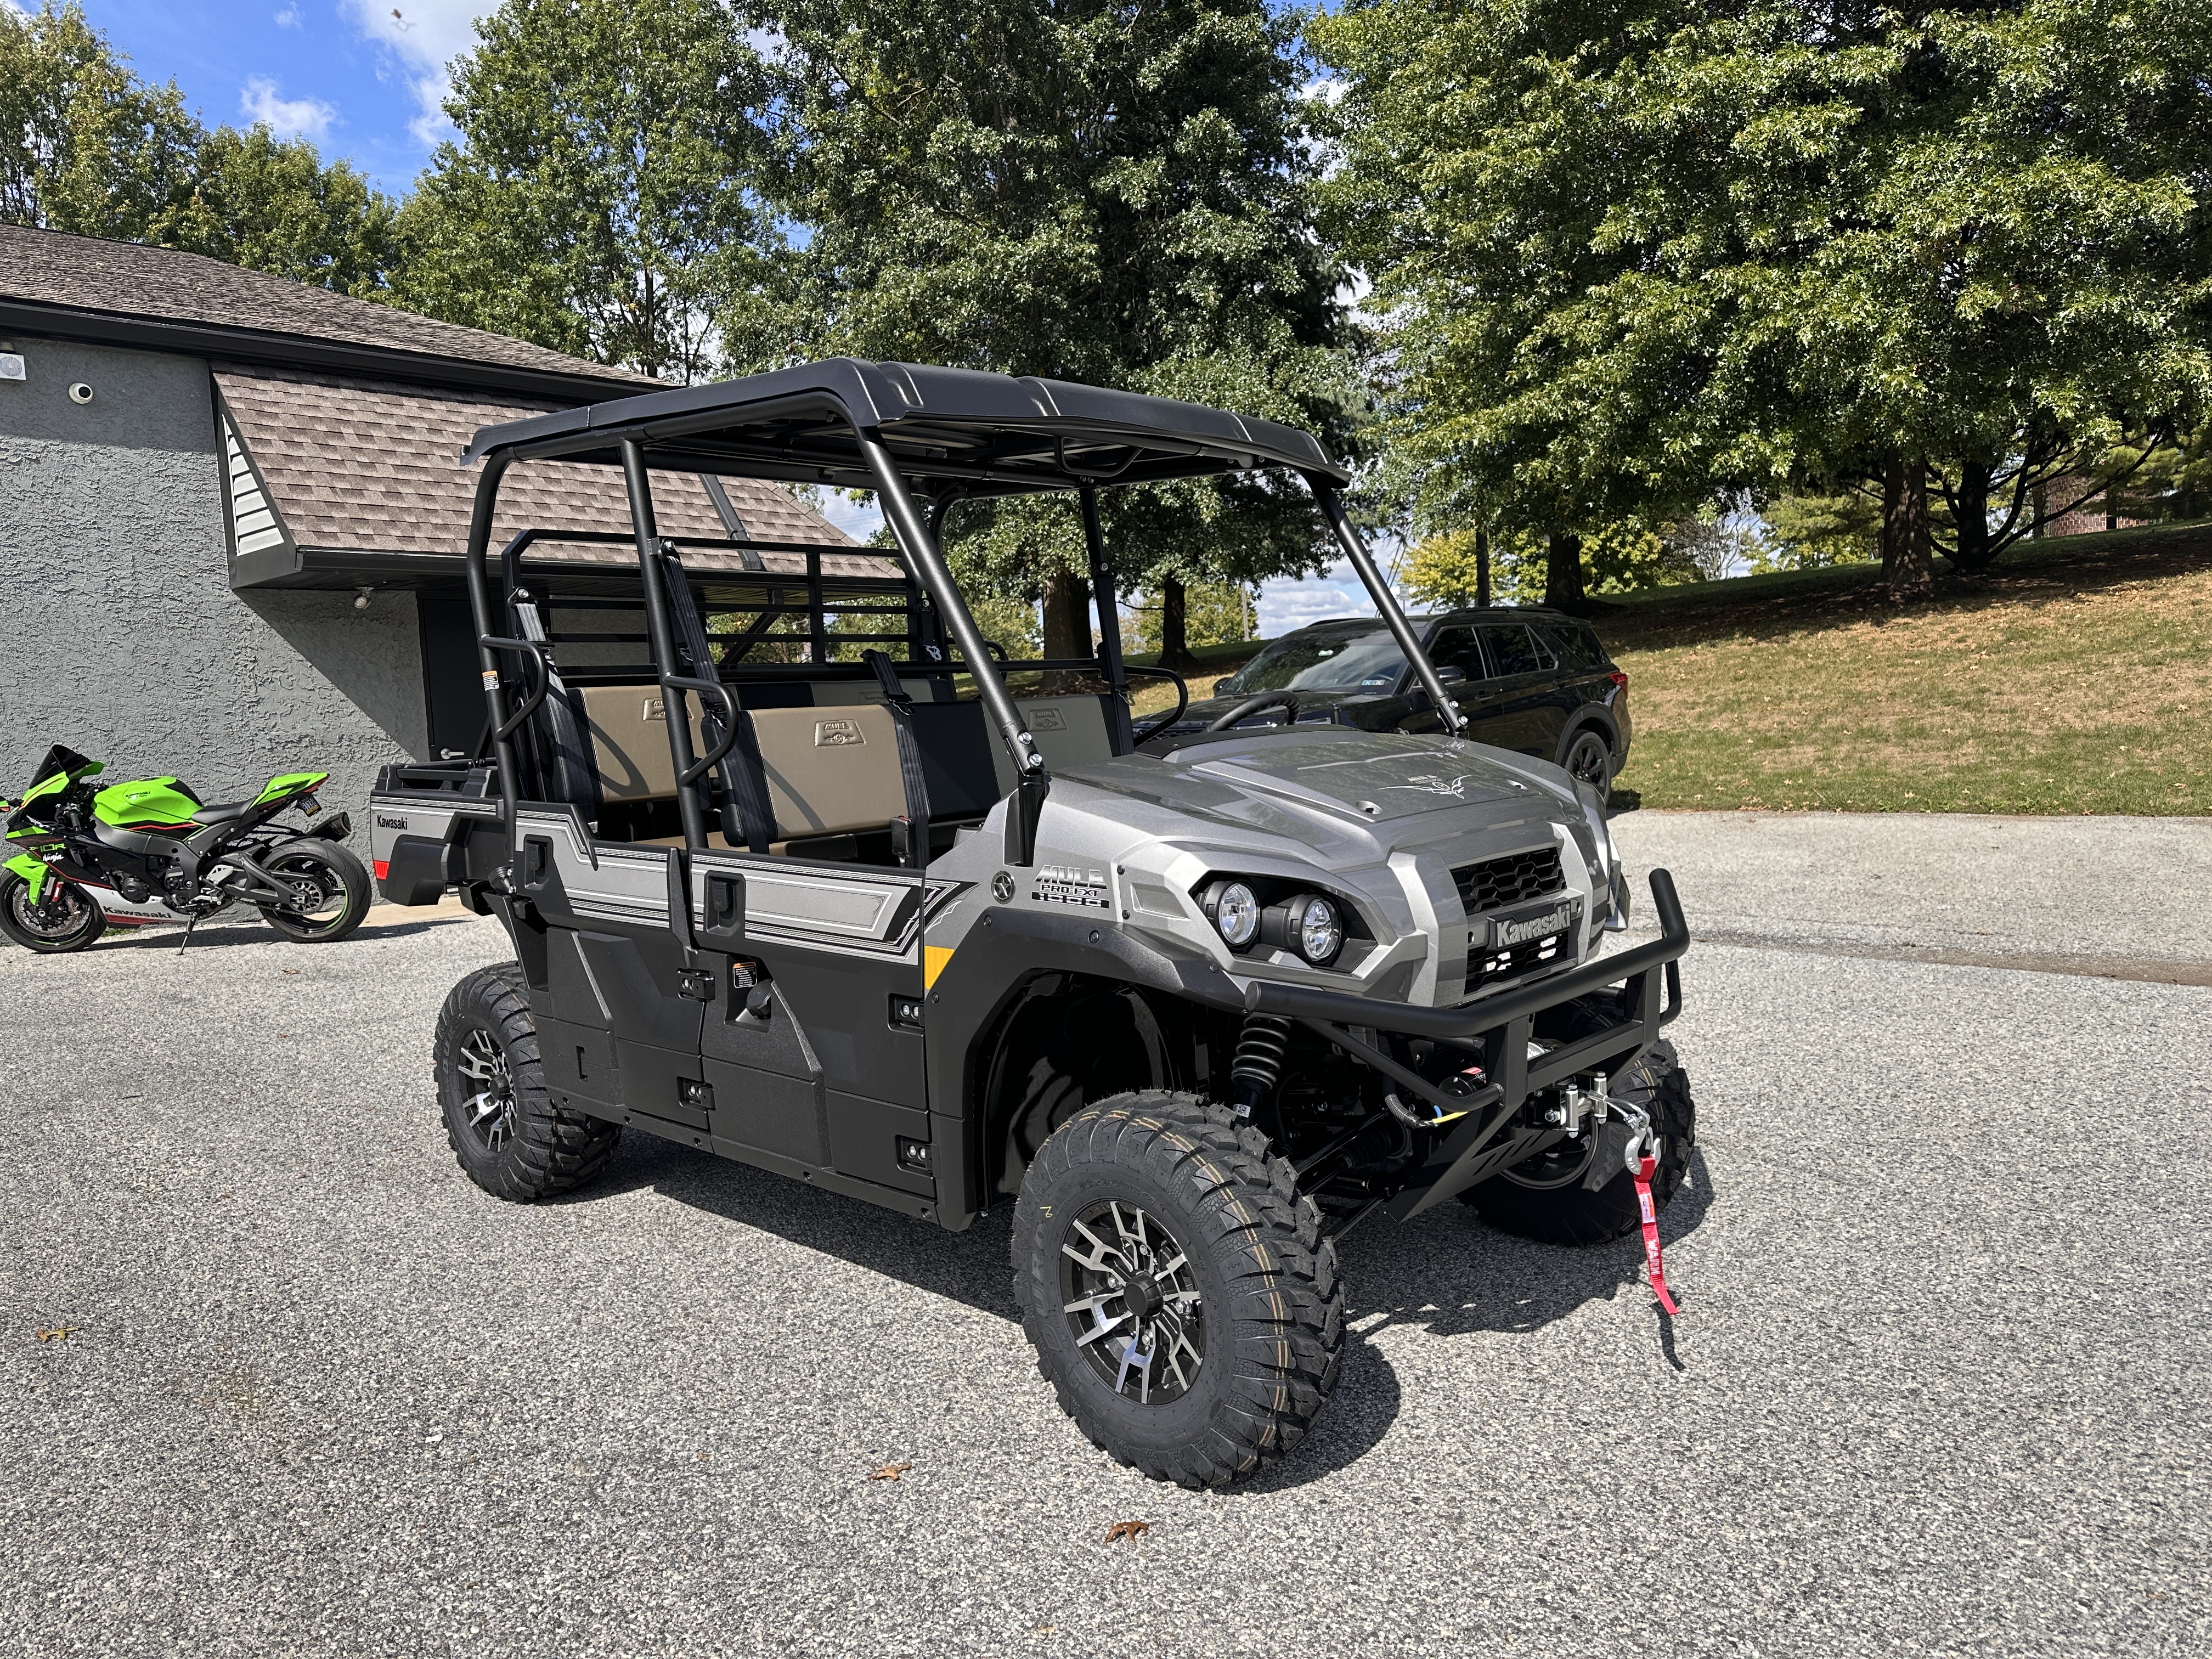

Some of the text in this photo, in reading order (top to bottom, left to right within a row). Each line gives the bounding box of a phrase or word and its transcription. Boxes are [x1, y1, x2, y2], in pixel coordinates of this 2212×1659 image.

[825, 722, 850, 730] MULE
[377, 814, 408, 830] Kawasaki
[42, 852, 64, 863] Ninja
[1035, 865, 1108, 889] MULE
[1038, 893, 1102, 907] 1000
[102, 906, 172, 918] Kawasaki
[1497, 904, 1571, 947] Kawasaki
[1030, 1220, 1063, 1351] DURO
